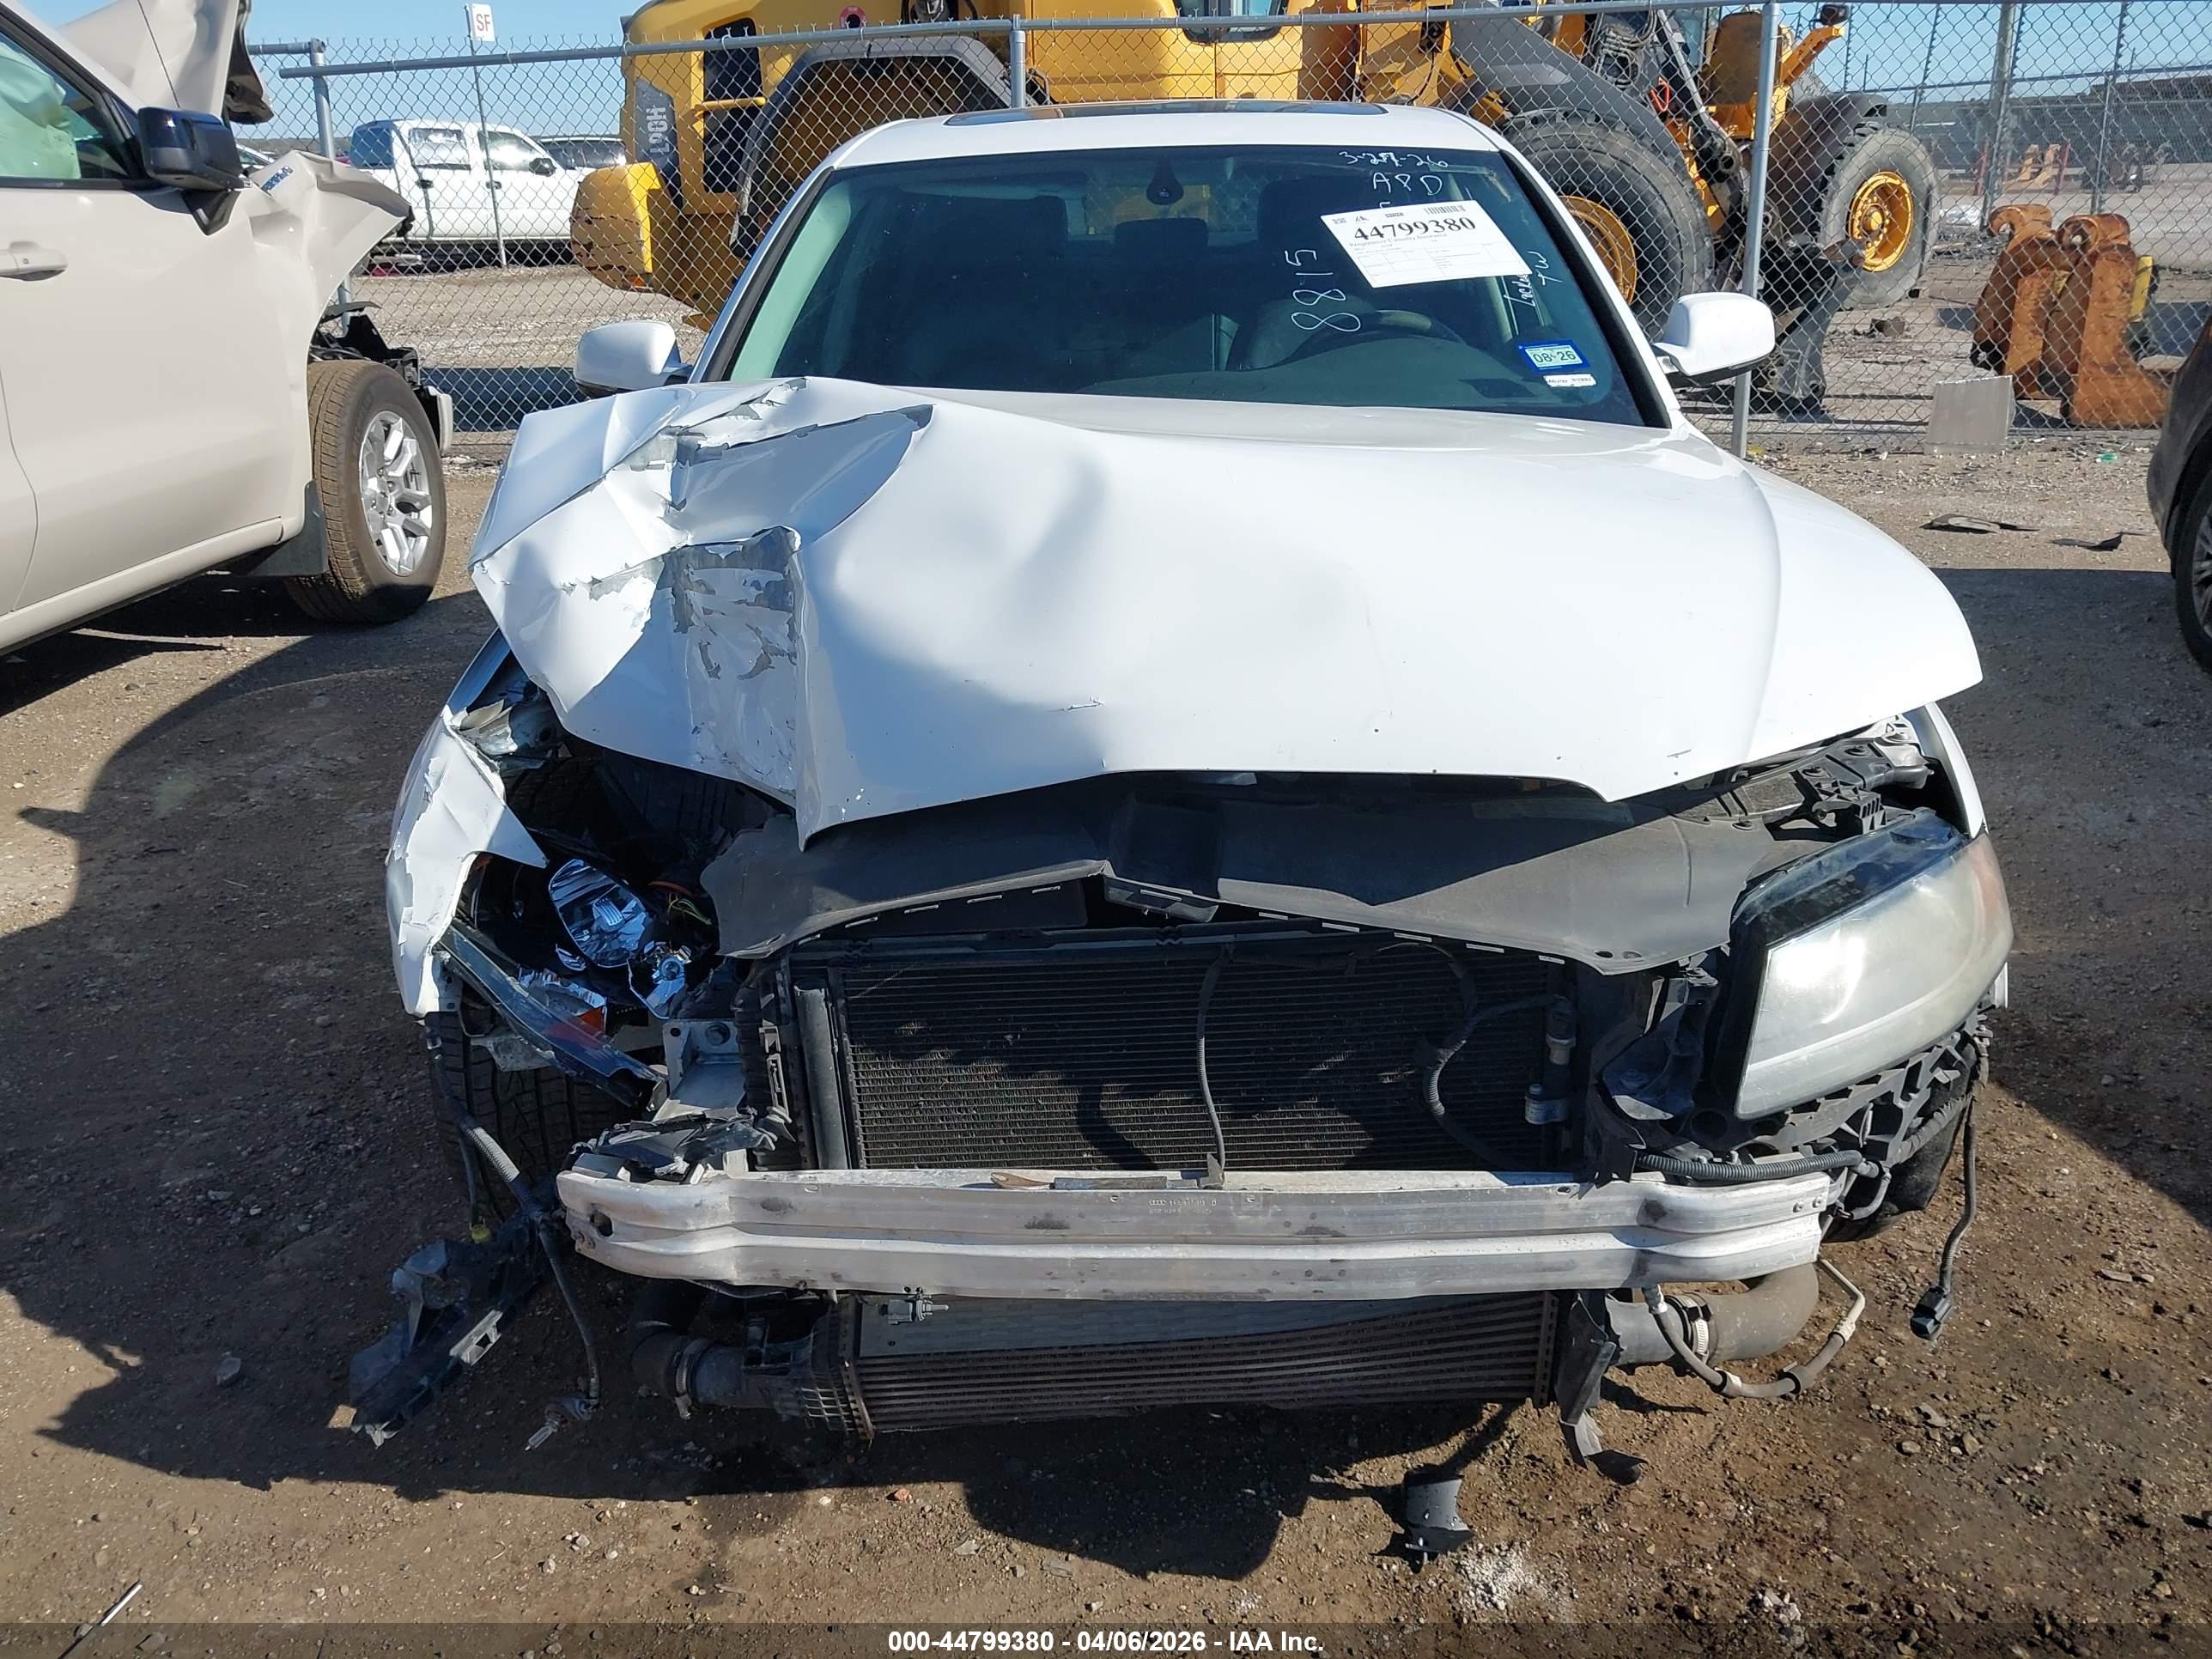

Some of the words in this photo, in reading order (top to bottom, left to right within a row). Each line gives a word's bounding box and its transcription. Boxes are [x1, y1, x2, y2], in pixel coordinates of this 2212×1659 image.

[476, 13, 490, 33] SF
[1354, 216, 1476, 240] 44799380
[1285, 250, 1361, 332] 8815
[1533, 353, 1553, 363] 08
[1557, 350, 1577, 361] 26
